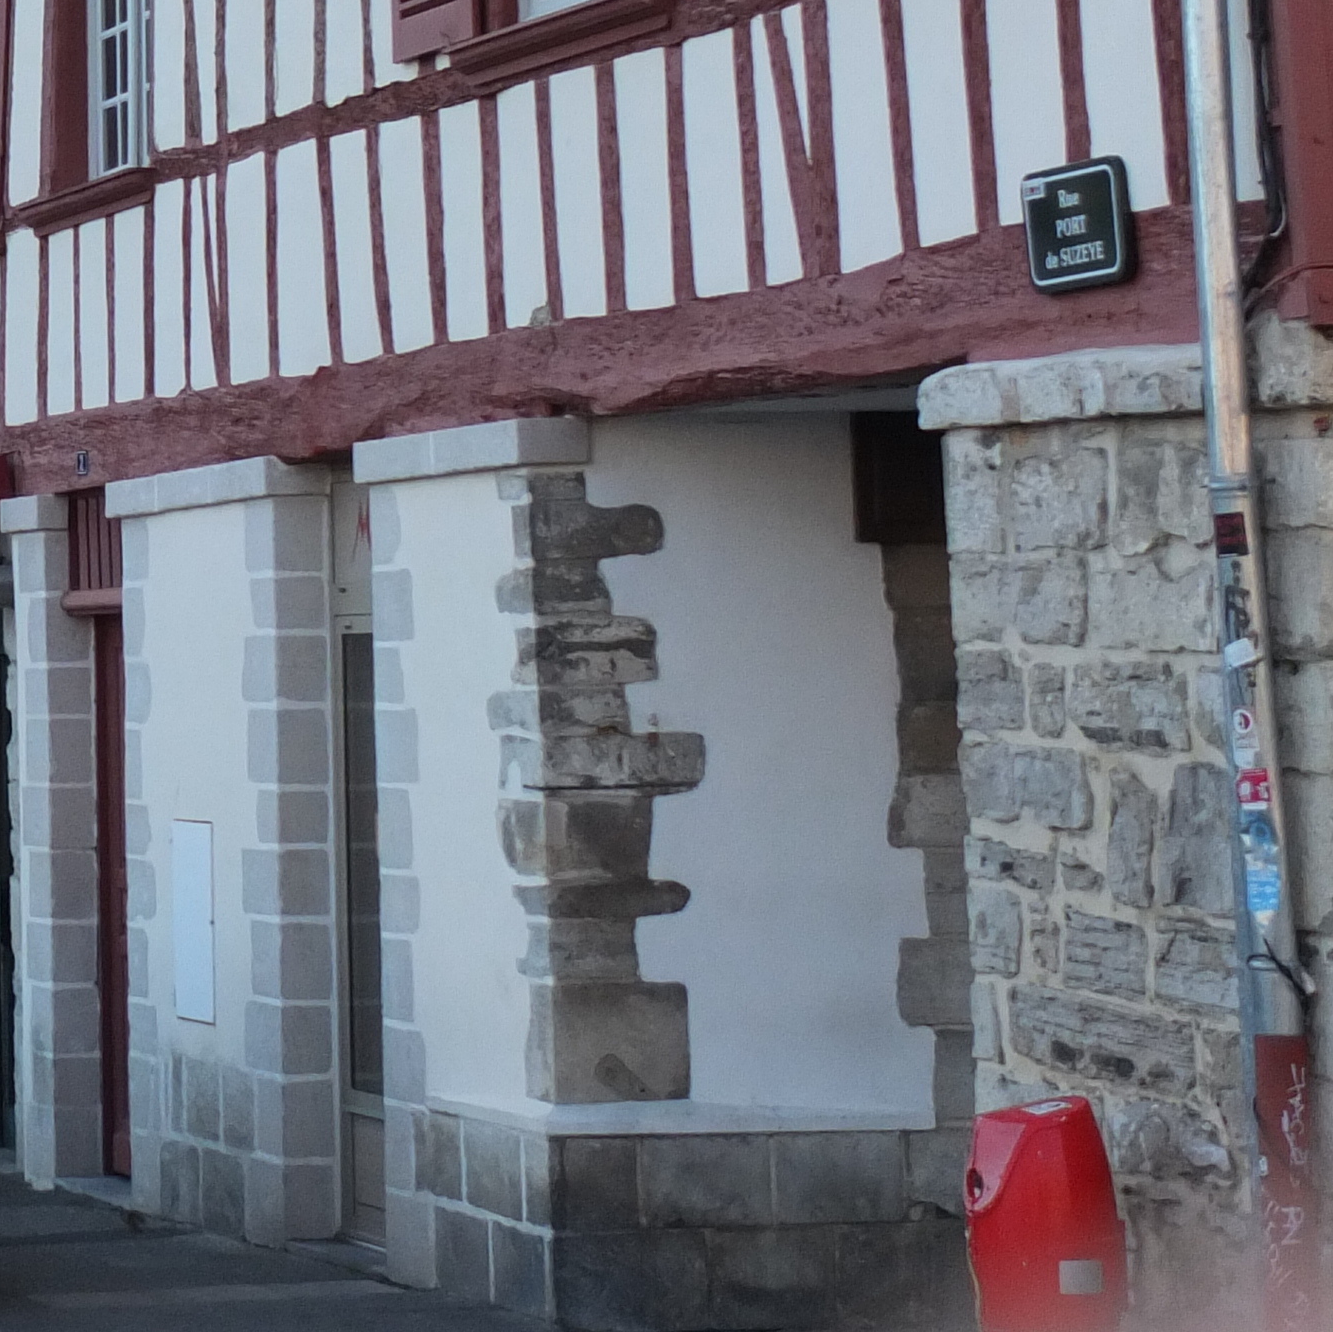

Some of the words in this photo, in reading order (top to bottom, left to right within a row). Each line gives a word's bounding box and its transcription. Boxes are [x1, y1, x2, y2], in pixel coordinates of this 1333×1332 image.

[1057, 189, 1079, 208] Rue
[1055, 214, 1087, 239] PORT
[1045, 251, 1059, 270] de
